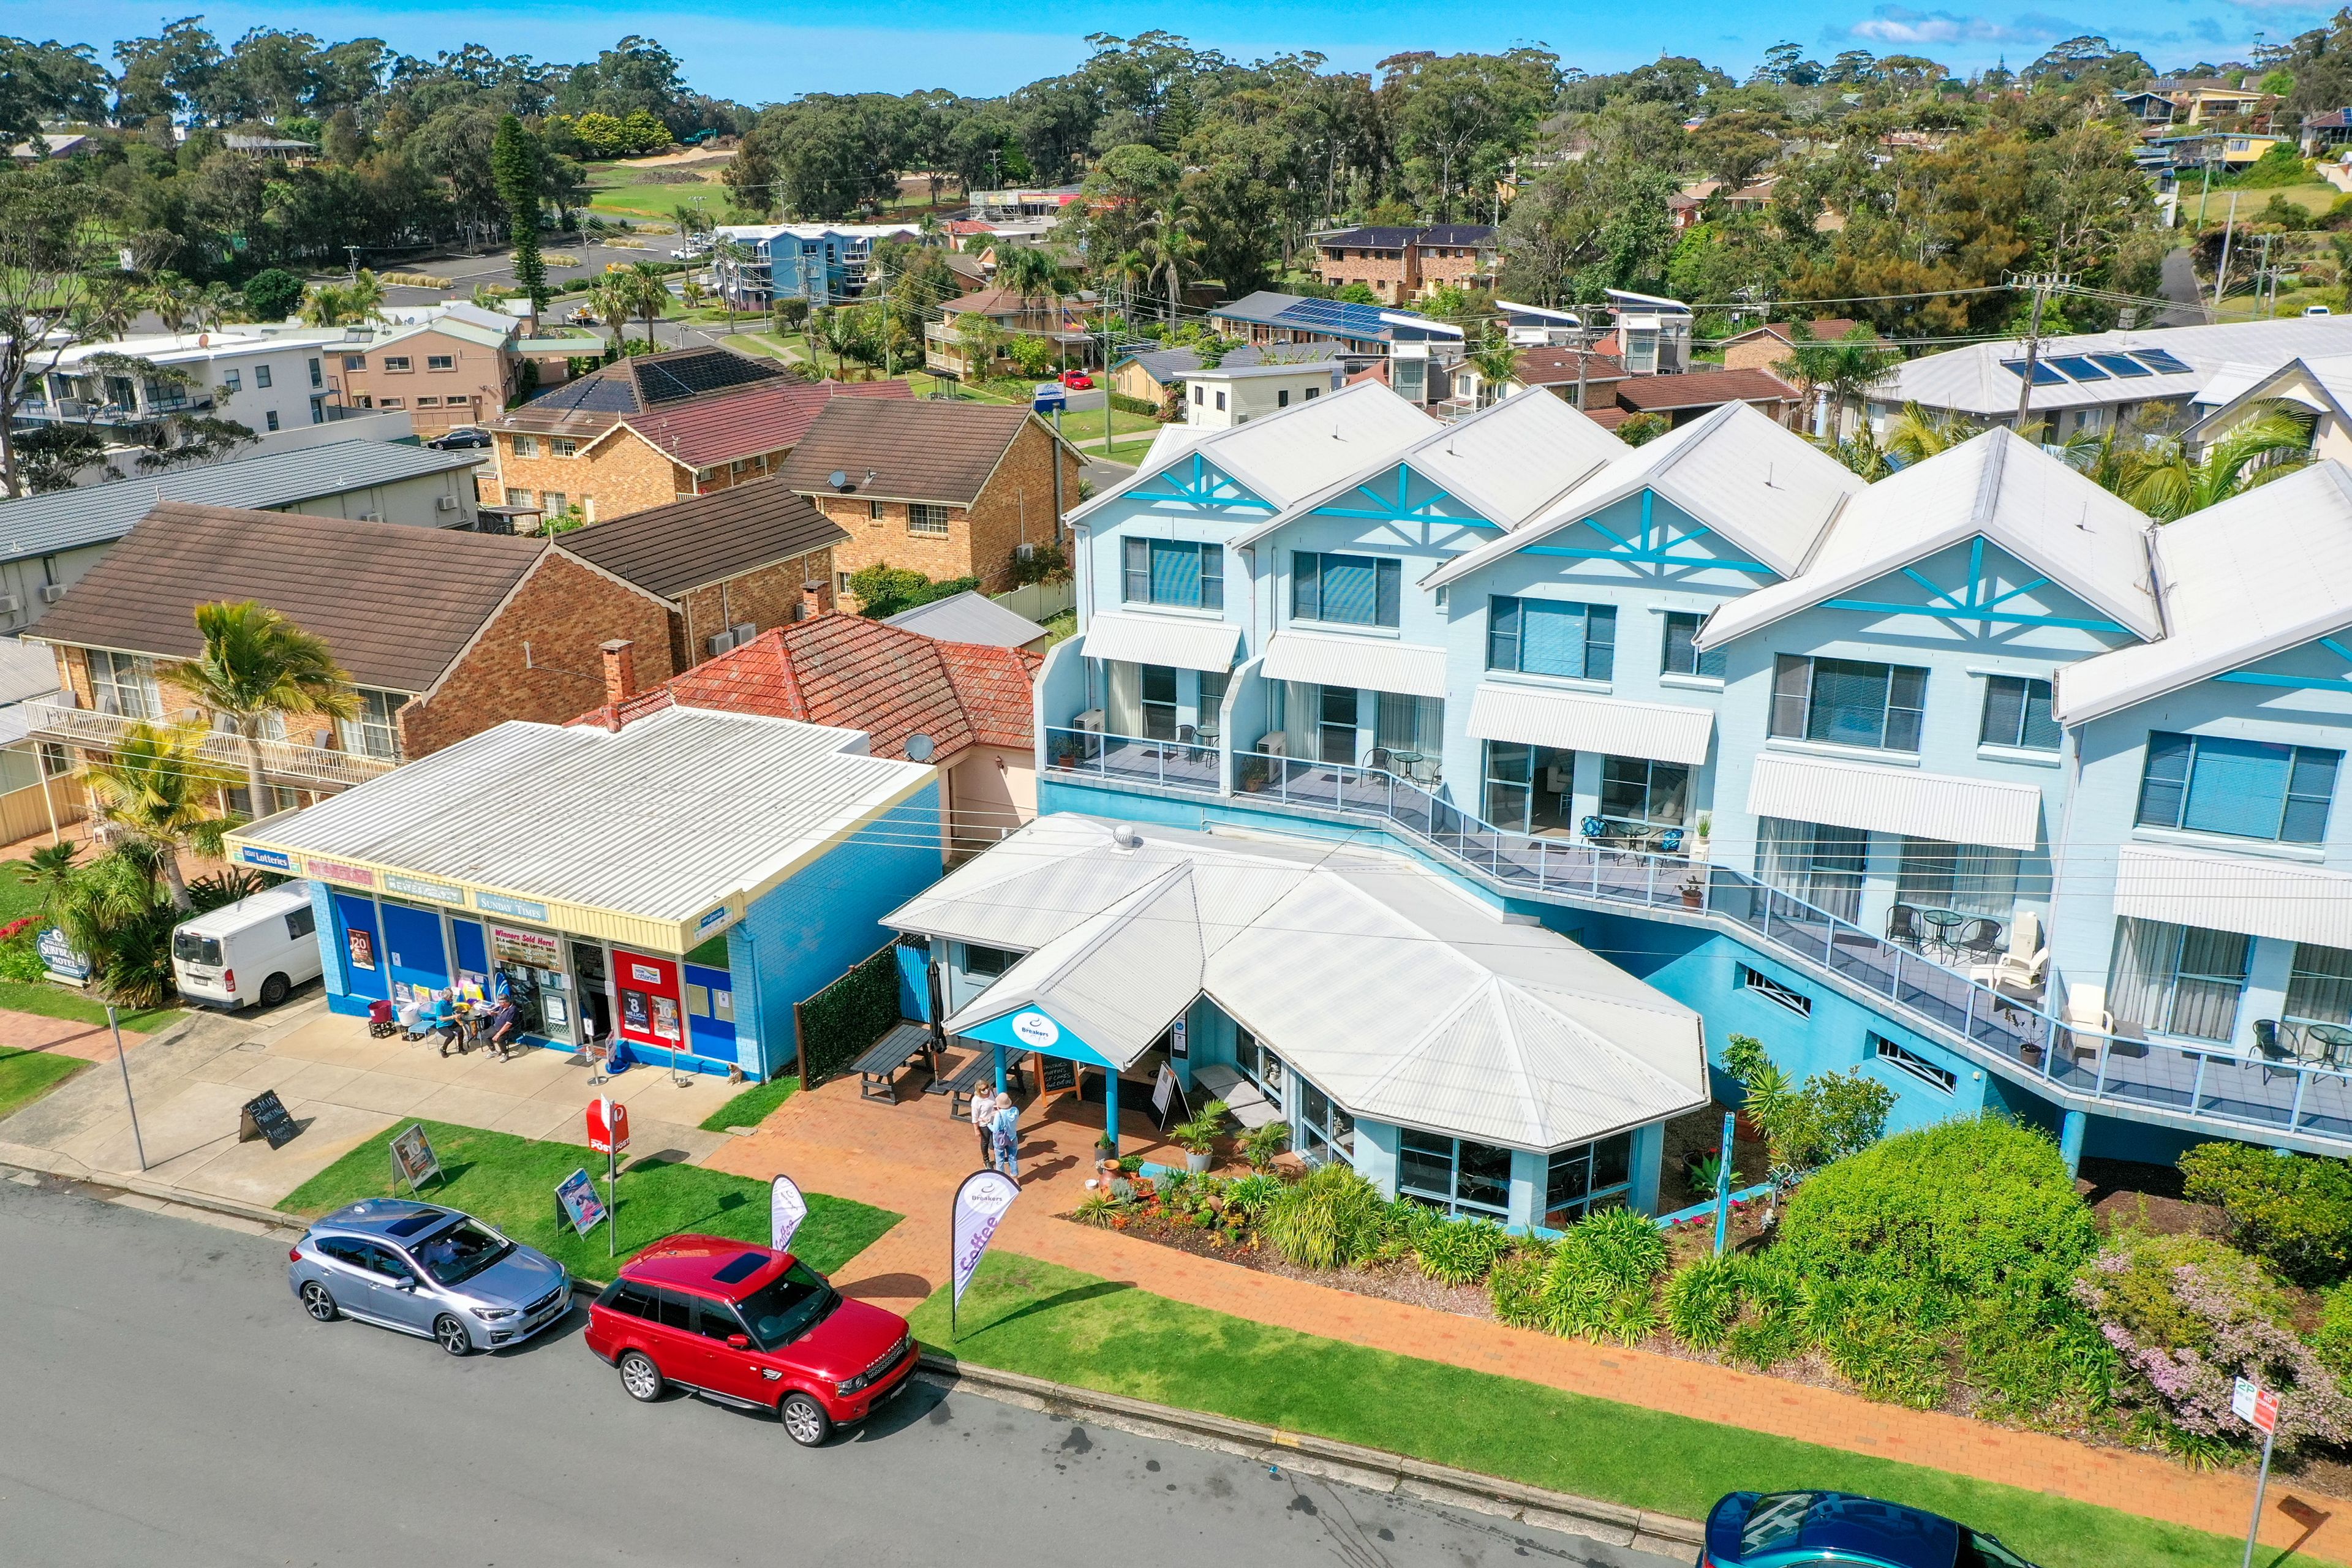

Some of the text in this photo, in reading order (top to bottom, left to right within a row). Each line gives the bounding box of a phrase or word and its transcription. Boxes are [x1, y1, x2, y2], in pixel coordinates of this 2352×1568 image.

[256, 852, 287, 866] Lotteries
[481, 897, 511, 912] SUNDAY
[515, 905, 541, 918] TIMES
[44, 939, 69, 949] MOLLYMO
[496, 929, 554, 948] Winners Sold Here!
[52, 955, 78, 968] MOTEL
[635, 971, 658, 982] Lotteries
[625, 1010, 646, 1019] MILLION
[1022, 1027, 1049, 1037] Breakers
[258, 1095, 277, 1110] MIN
[255, 1106, 285, 1125] PARKING
[615, 1139, 629, 1152] POST
[960, 1217, 999, 1271] Coffee
[866, 1337, 902, 1368] RANGE ROVER
[2237, 1380, 2255, 1393] 2P
[2263, 1393, 2272, 1404] NO
